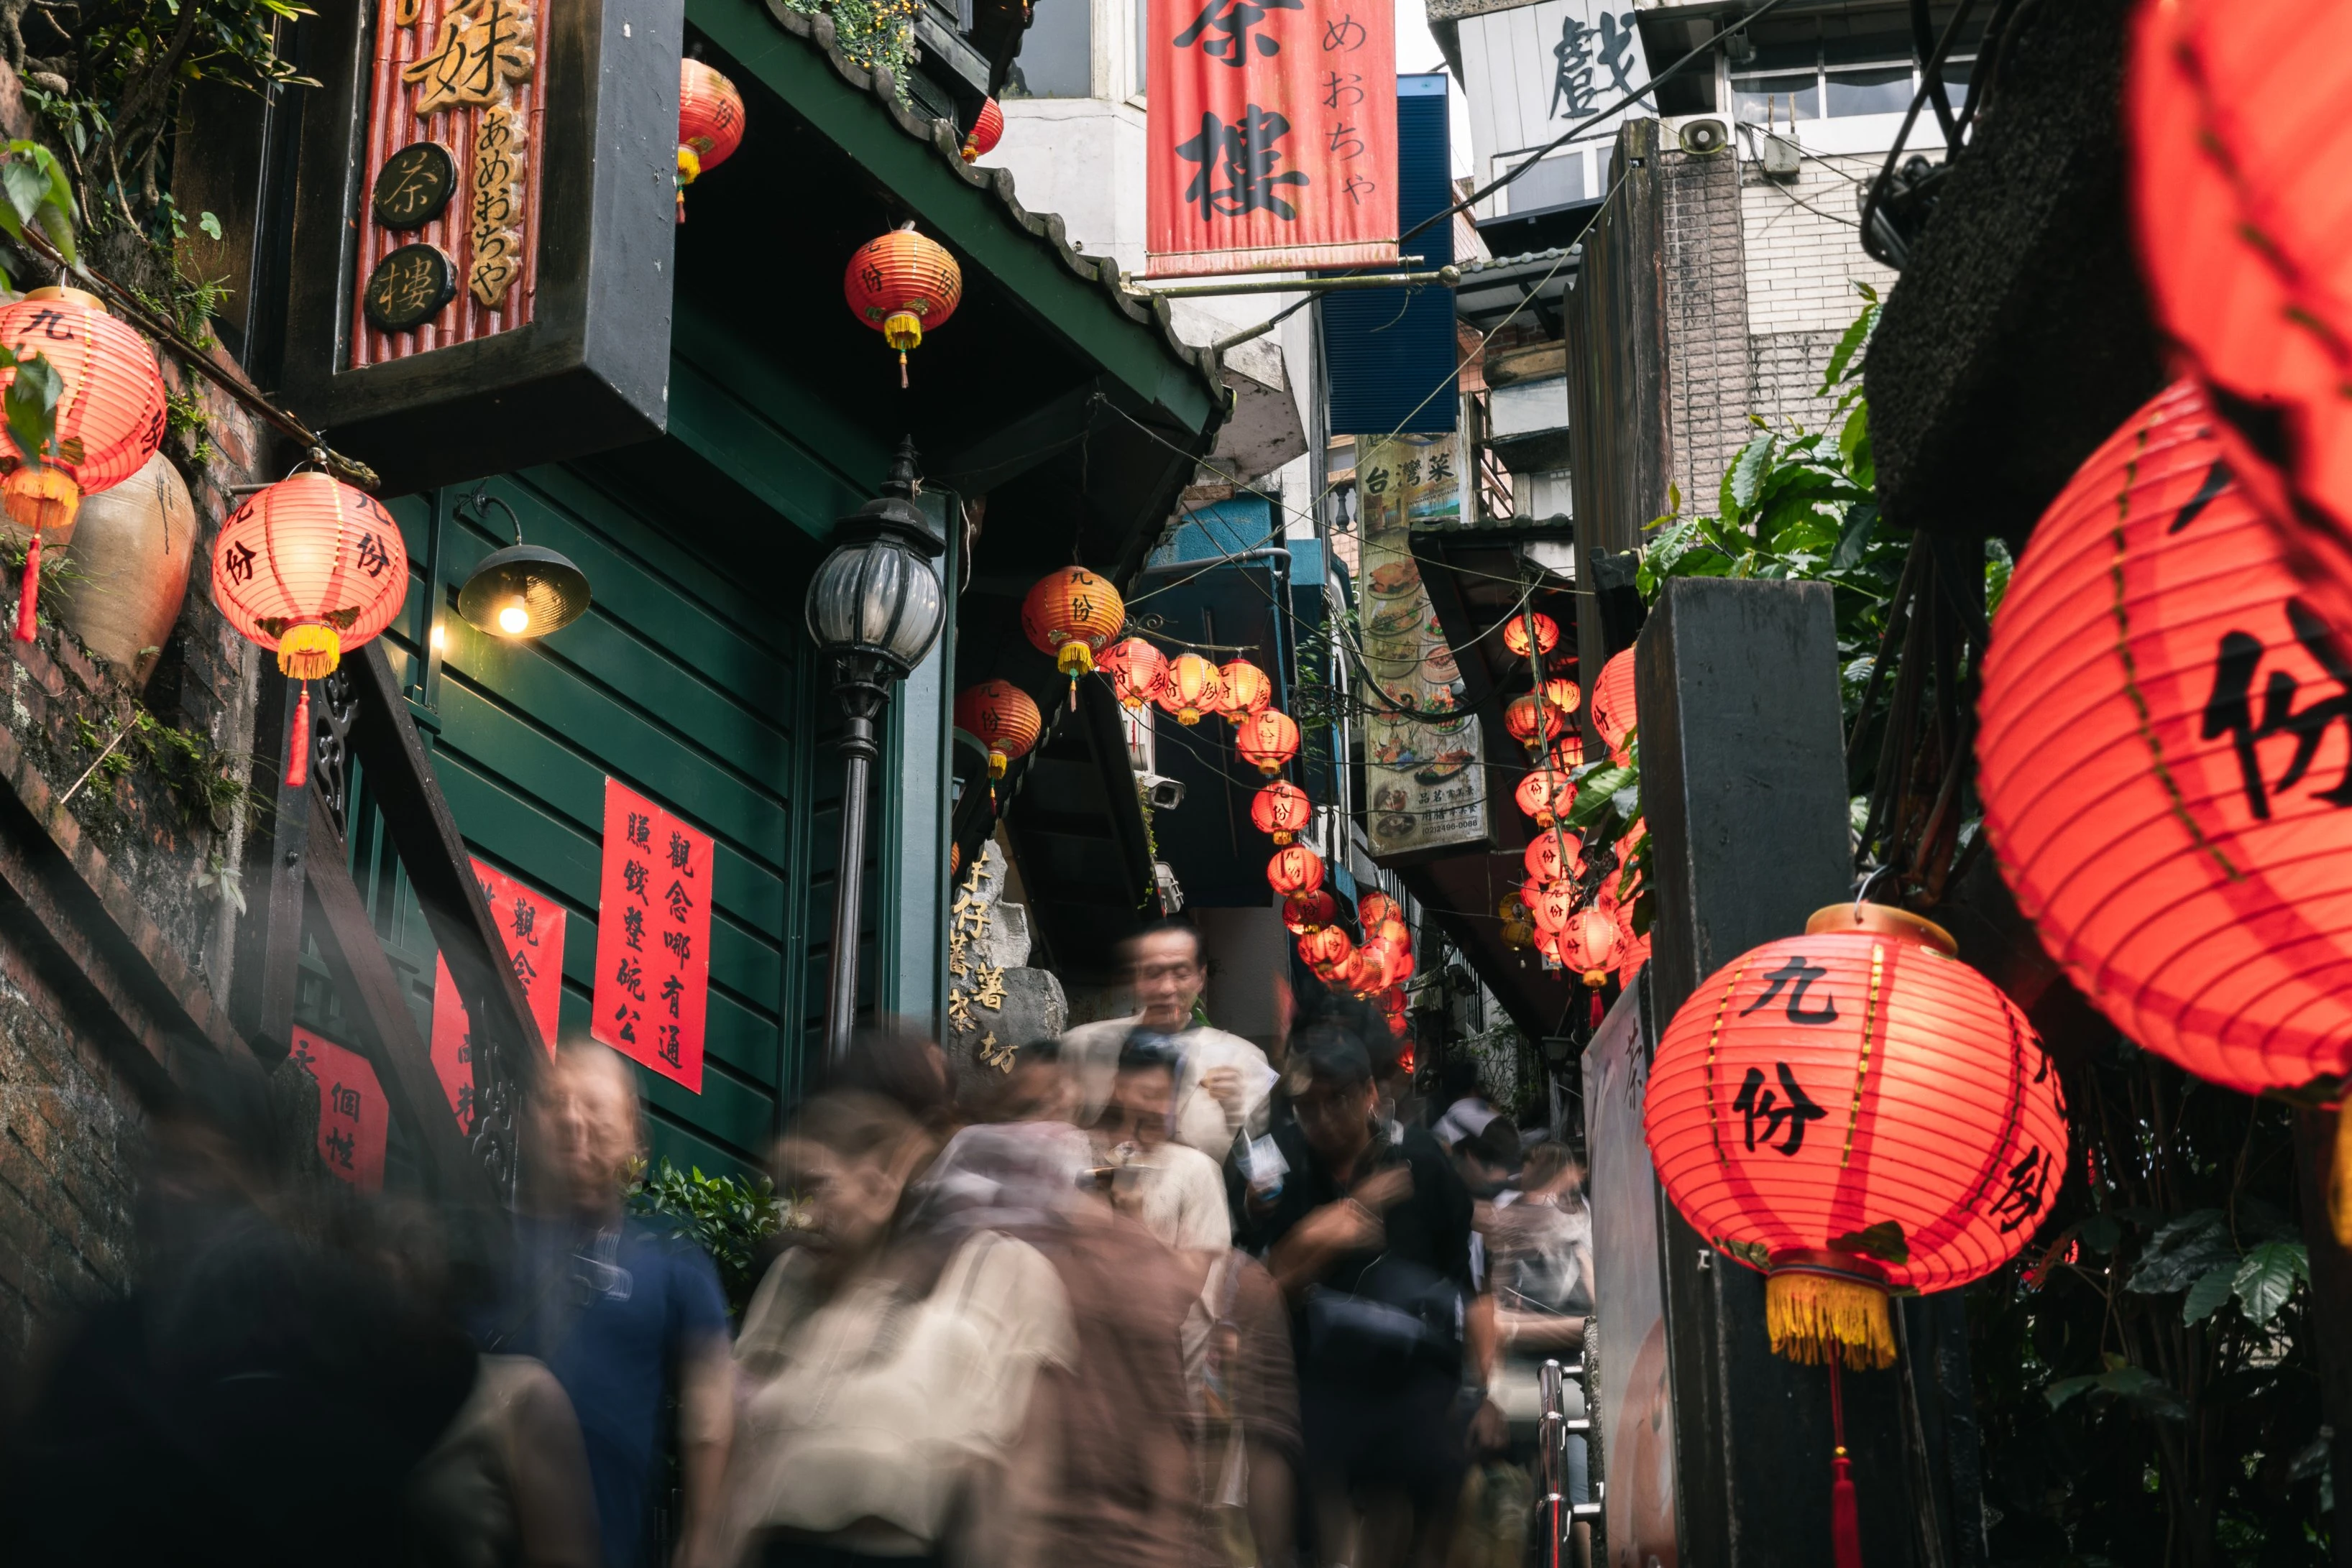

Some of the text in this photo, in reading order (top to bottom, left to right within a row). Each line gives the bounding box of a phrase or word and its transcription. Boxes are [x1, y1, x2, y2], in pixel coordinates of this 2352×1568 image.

[403, 0, 523, 103] 妹
[377, 152, 438, 315] 茶樓
[1365, 453, 1454, 494] 台灣菜
[354, 492, 391, 578] 九份
[1071, 571, 1094, 622] 九份
[978, 684, 1001, 732] 九份
[1541, 835, 1556, 863] 九份
[658, 830, 694, 1069] 觀念哪有通
[1733, 956, 1839, 1157] 九份
[325, 1081, 362, 1171] 個性
